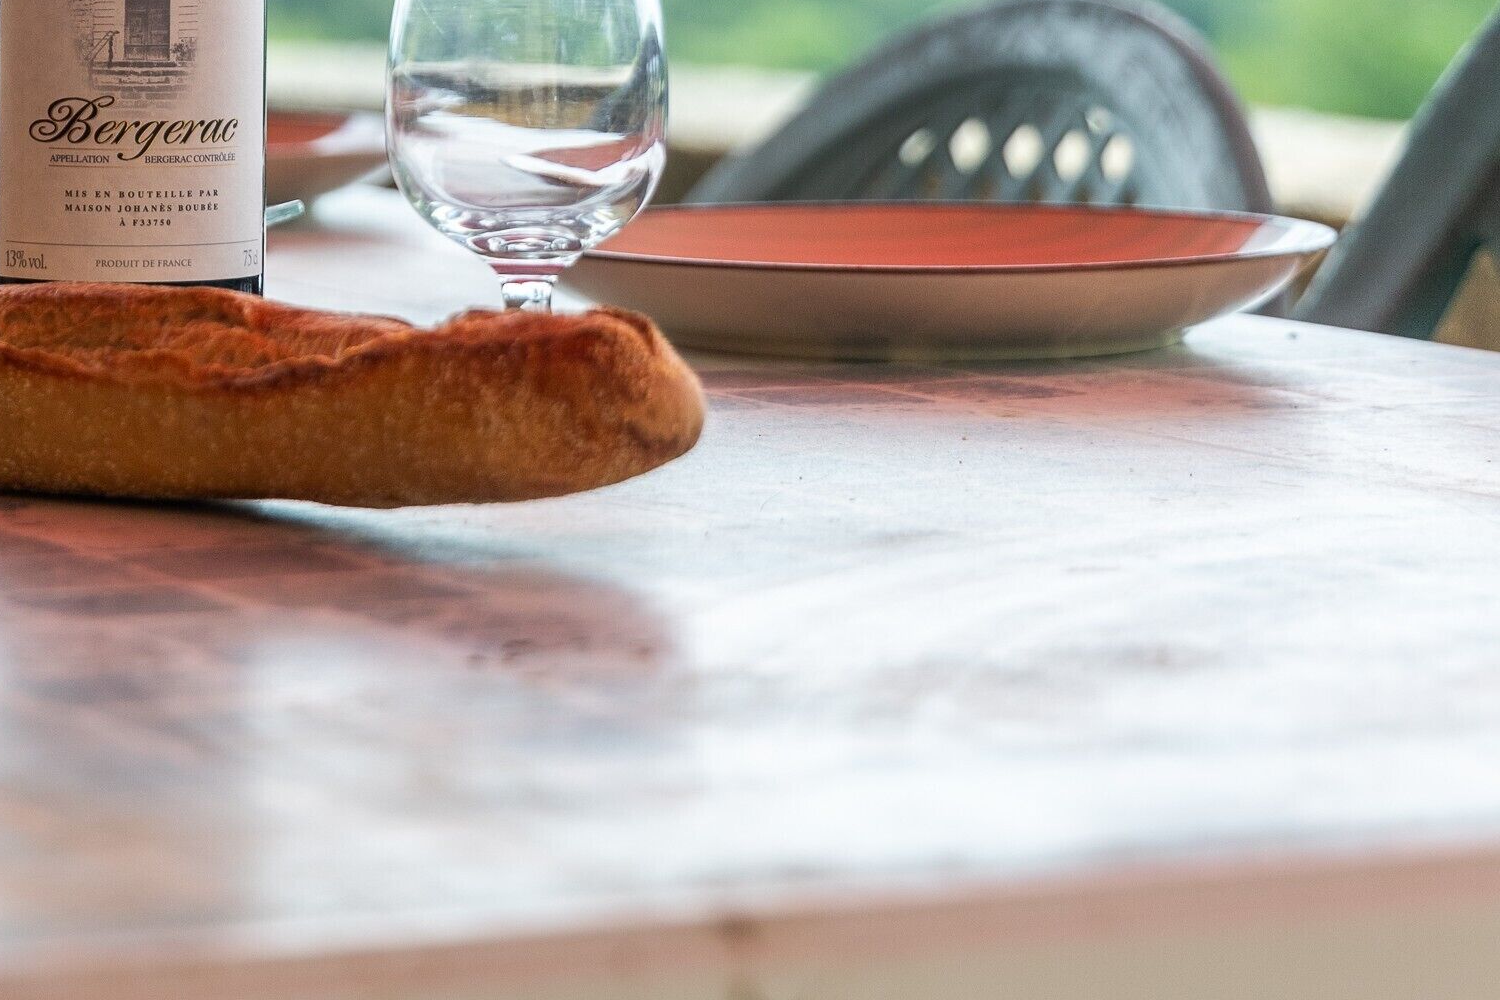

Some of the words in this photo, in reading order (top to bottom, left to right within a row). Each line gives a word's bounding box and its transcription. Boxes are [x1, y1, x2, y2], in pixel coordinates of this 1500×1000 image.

[28, 94, 239, 161] Bergerac
[50, 154, 110, 164] APPELLATION
[144, 155, 193, 164] BERGERAC
[193, 151, 236, 163] CONTRÔLÉE
[64, 189, 88, 198] MIS
[95, 190, 111, 198] EN
[118, 190, 193, 199] BOUTEILLE
[199, 189, 219, 197] PAR
[64, 203, 111, 212] MAISON
[117, 202, 172, 213] JOHANÈS
[178, 202, 219, 212] BOUBÉE
[119, 217, 126, 227] À
[132, 218, 172, 227] F33750
[5, 249, 27, 268] 13%
[28, 253, 48, 270] vol.
[95, 259, 140, 268] PRODUIT
[142, 259, 155, 268] DE
[157, 258, 192, 268] FRANCE
